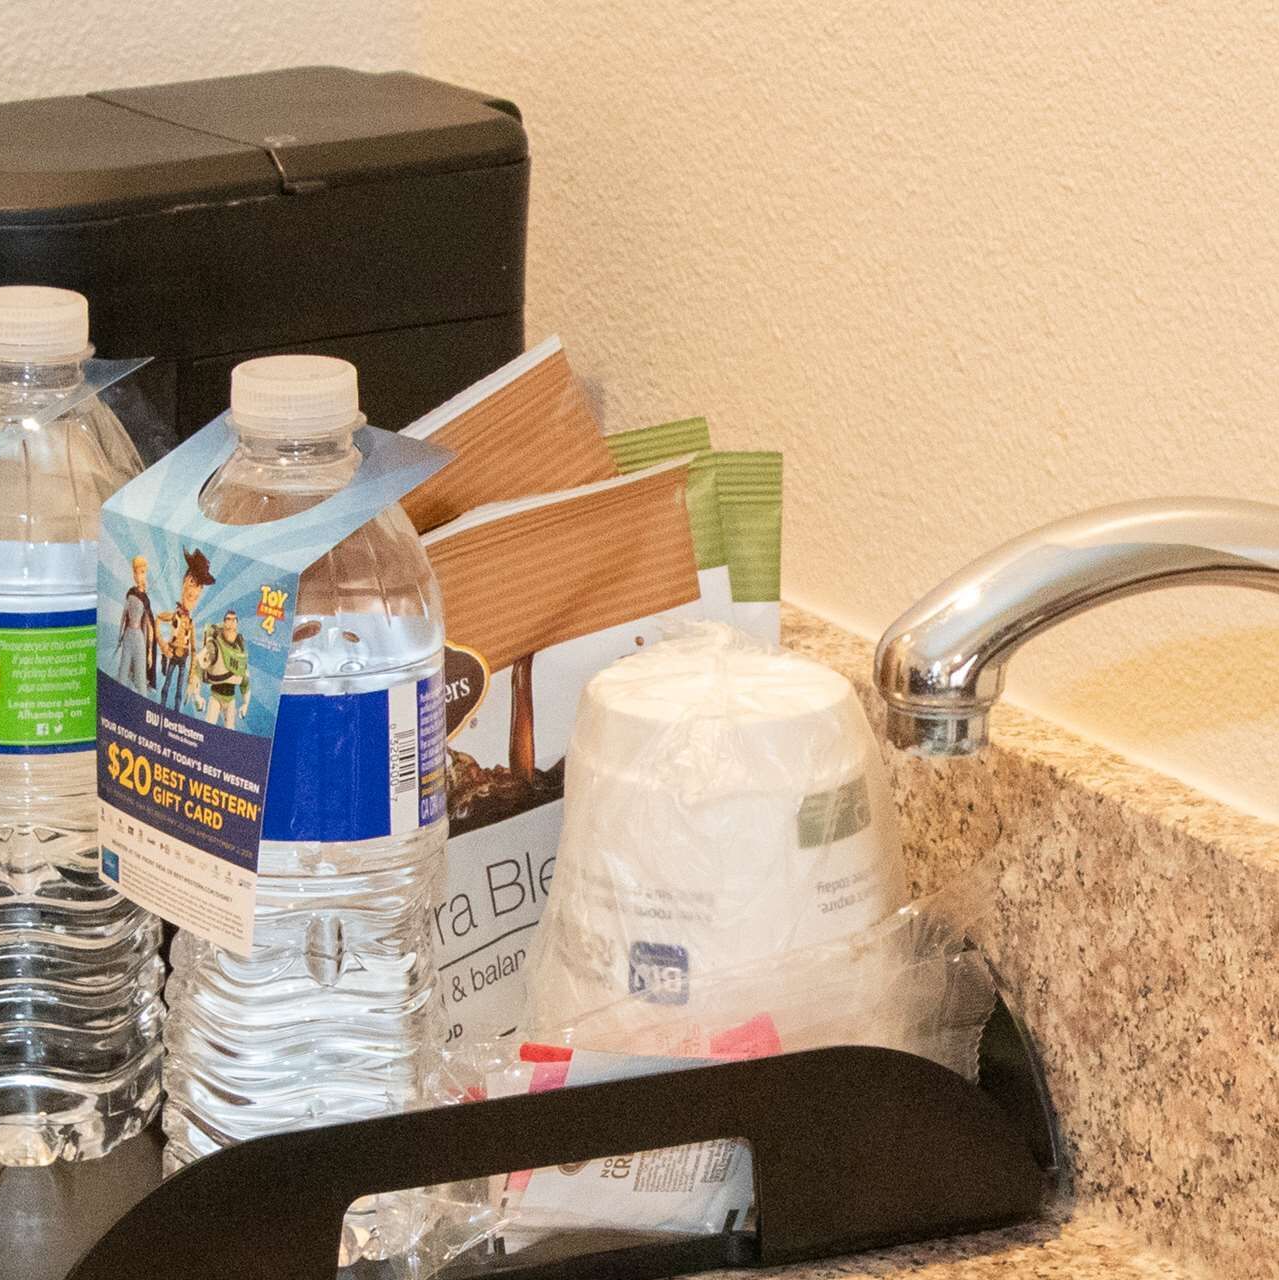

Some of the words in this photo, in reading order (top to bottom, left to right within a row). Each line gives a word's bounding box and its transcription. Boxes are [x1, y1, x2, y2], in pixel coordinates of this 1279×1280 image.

[261, 586, 288, 608] TOY
[262, 615, 274, 635] 4
[101, 717, 119, 732] YOUR
[118, 724, 138, 743] STORY
[138, 735, 162, 755] STARTS
[162, 746, 172, 759] AT
[172, 751, 202, 772] TODAY'S
[202, 762, 222, 779] BEST
[222, 770, 260, 795] WESTERN
[107, 742, 152, 797] $20
[154, 763, 186, 791] BEST
[152, 786, 182, 812] GIFT
[184, 800, 223, 830] CARD
[451, 975, 468, 1002] &
